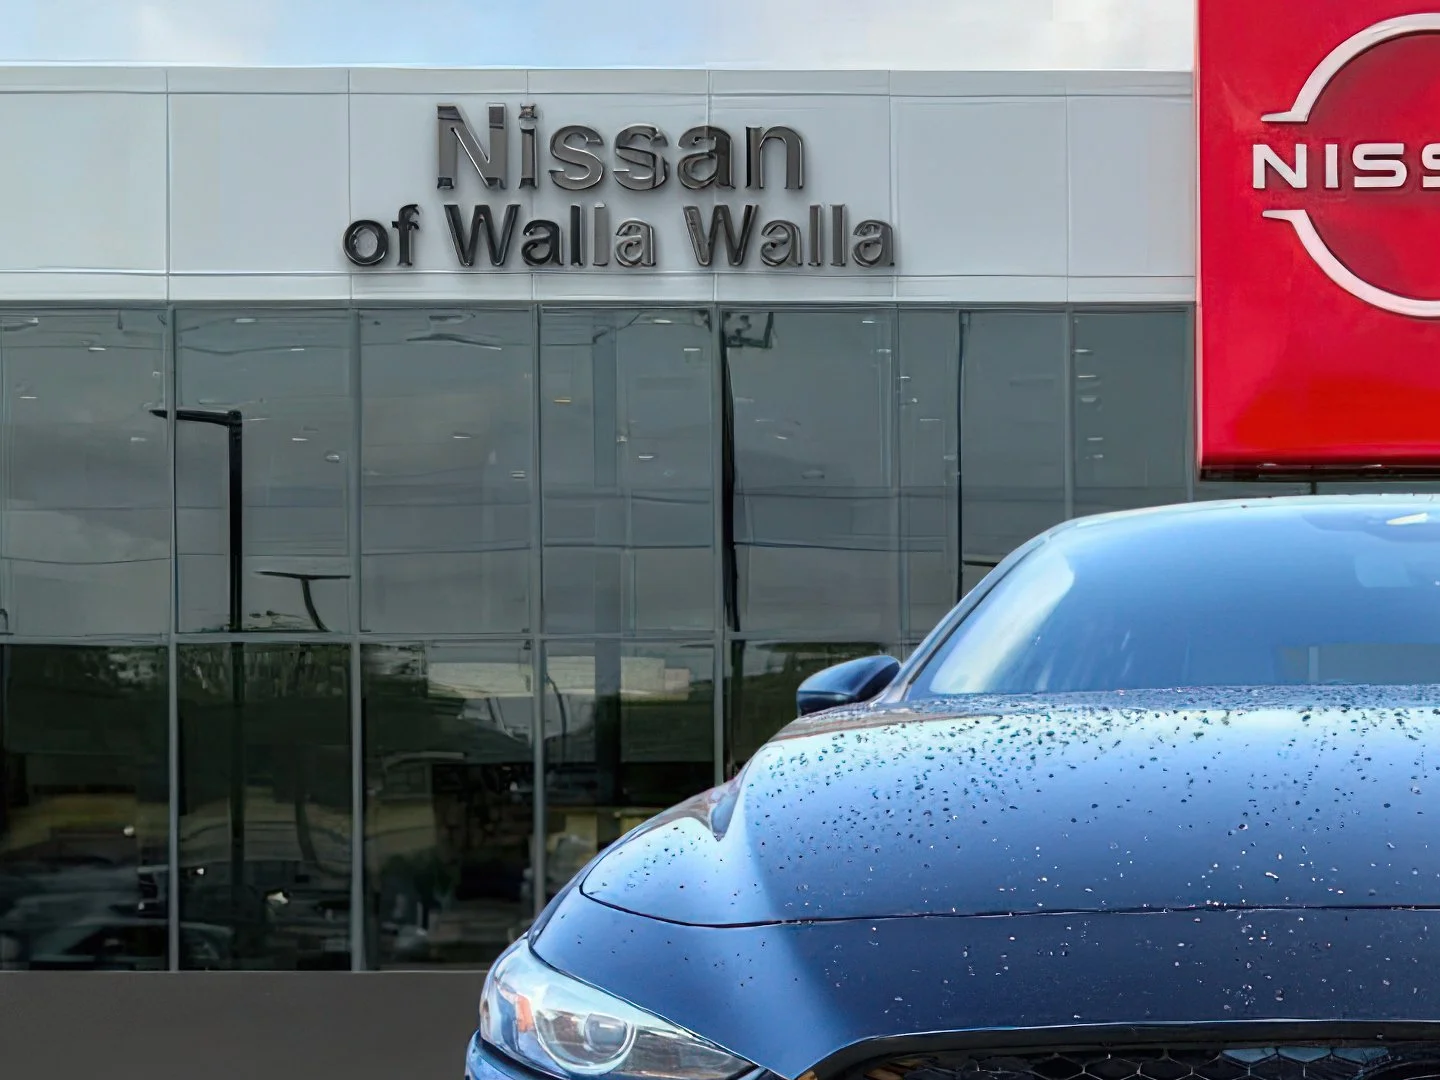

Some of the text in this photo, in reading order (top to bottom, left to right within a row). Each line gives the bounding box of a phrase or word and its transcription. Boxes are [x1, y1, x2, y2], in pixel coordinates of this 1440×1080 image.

[436, 103, 804, 190] Nissan
[342, 203, 897, 267] of Walla Walla
